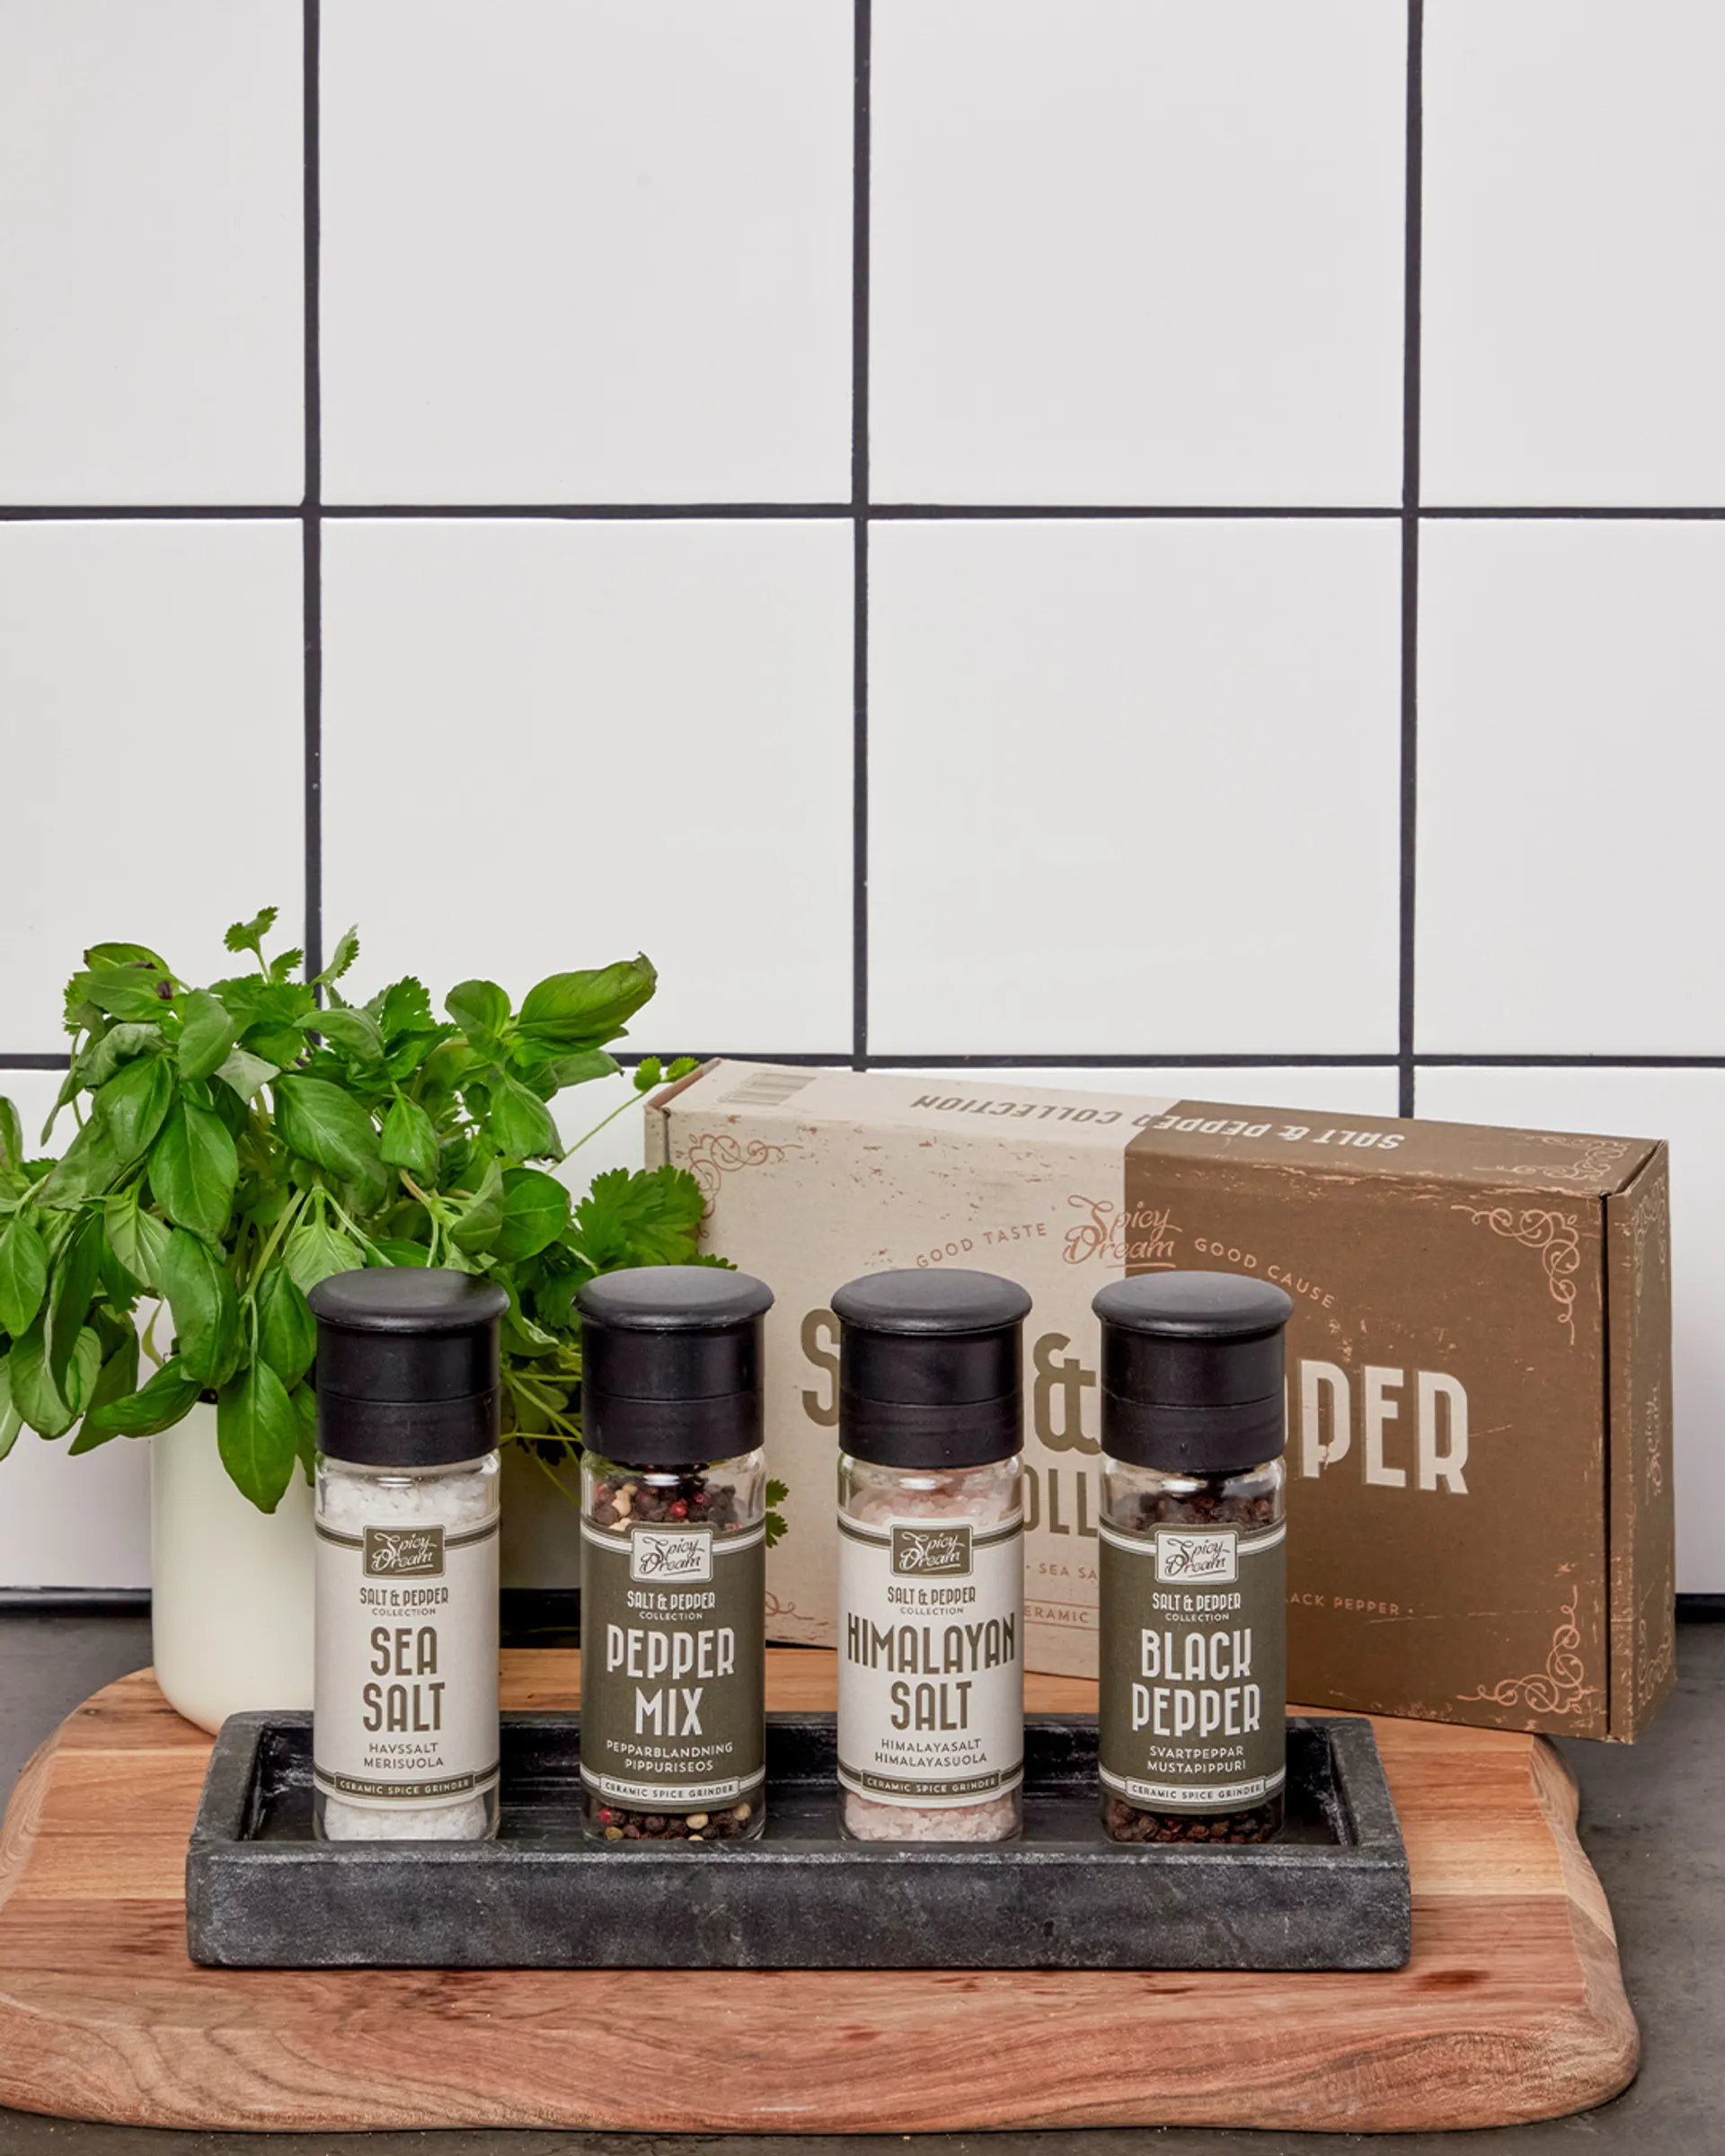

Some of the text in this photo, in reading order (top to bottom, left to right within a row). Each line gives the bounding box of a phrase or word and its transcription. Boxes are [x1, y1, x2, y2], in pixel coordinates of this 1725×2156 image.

[909, 1095, 1406, 1150] SALT & PEPPER COLLECTION
[1067, 1195, 1182, 1242] Spicy
[916, 1223, 1047, 1268] GOOD TASTE
[1062, 1225, 1175, 1265] Dream
[1194, 1238, 1336, 1309] GOOD CAUSE
[373, 1532, 438, 1559] Spicy
[642, 1536, 705, 1561] Spicy
[901, 1531, 966, 1558] Spicy
[1166, 1537, 1231, 1564] Spicy
[371, 1549, 434, 1571] Dream
[640, 1553, 702, 1574] Dream
[899, 1547, 961, 1570] Dream
[1164, 1554, 1226, 1577] Dream
[359, 1586, 448, 1606] SALT & PEPPER
[888, 1586, 976, 1605] SALT & PEPPER
[1039, 1562, 1070, 1577] SEA
[1285, 1593, 1325, 1607] ACK
[1333, 1596, 1399, 1615] PEPPER
[627, 1590, 716, 1611] SALT & PEPPER
[1153, 1593, 1241, 1612] SALT & PEPPER
[372, 1608, 436, 1617] COLLECTION
[639, 1612, 703, 1621] COLLECTION
[899, 1607, 964, 1616] COLLECTION
[1023, 1604, 1089, 1624] ERAMIC
[1164, 1613, 1229, 1622] COLLECTION
[370, 1626, 438, 1676] SEA
[606, 1623, 735, 1680] PEPPER
[848, 1613, 1014, 1674] HIMALAYAN
[1141, 1629, 1252, 1681] BLACK
[362, 1682, 445, 1732] SALT
[635, 1686, 703, 1736] MIX
[890, 1681, 972, 1731] SALT
[1132, 1683, 1261, 1737] PEPPER
[369, 1742, 438, 1754] HAVSSALT
[606, 1739, 733, 1758] PEPPARBLANDNING
[881, 1738, 981, 1753] HIMALAYASALT
[1150, 1745, 1243, 1759] SVARTPEPPAR
[364, 1757, 444, 1769] MERISUOLA
[625, 1758, 713, 1772] PIPPURISEOS
[875, 1752, 986, 1767] HIMALAYASUOLA
[1147, 1760, 1246, 1773] MUSTAPIPPURI
[340, 1779, 470, 1795] CERAMIC SPICE GRINDER
[606, 1782, 733, 1798] CERAMIC SPICE GRINDER
[867, 1777, 995, 1793] CERAMIC SPICE GRINDER
[1132, 1785, 1261, 1799] CERAMIC SPICE GRINDER
